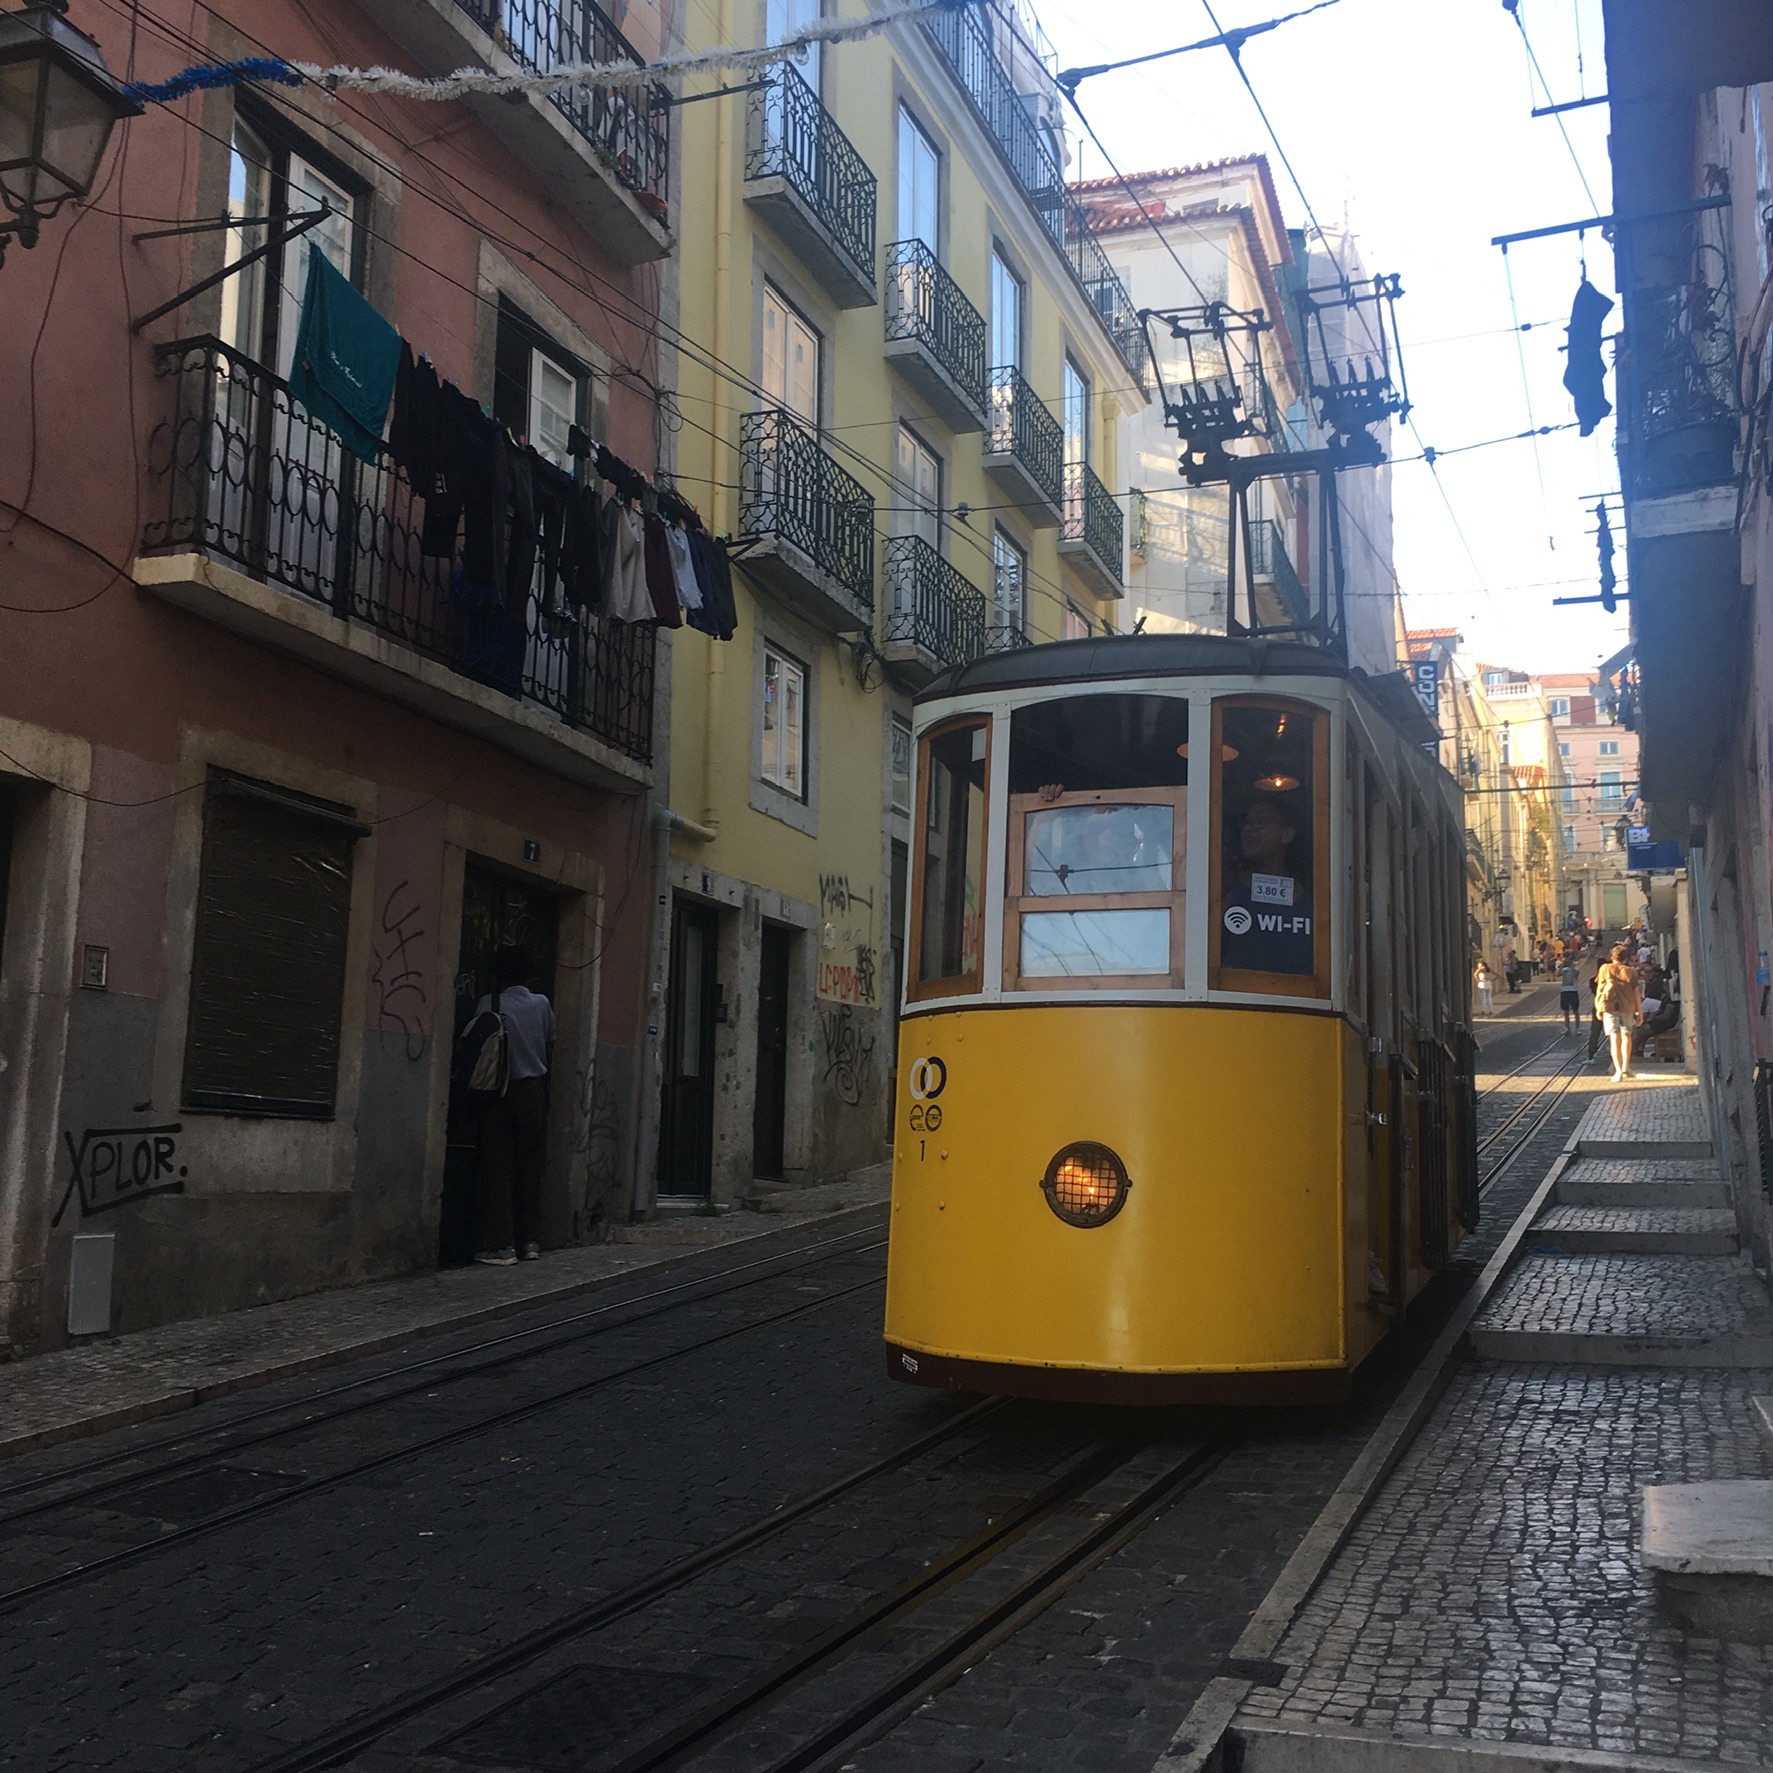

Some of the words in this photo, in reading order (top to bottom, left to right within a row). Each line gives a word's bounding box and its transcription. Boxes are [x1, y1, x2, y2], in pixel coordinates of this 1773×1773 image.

[530, 843, 536, 860] 7
[1257, 885, 1277, 897] 3.80
[1279, 888, 1286, 898] €
[1257, 913, 1310, 935] WI-FI
[920, 1140, 925, 1162] 1
